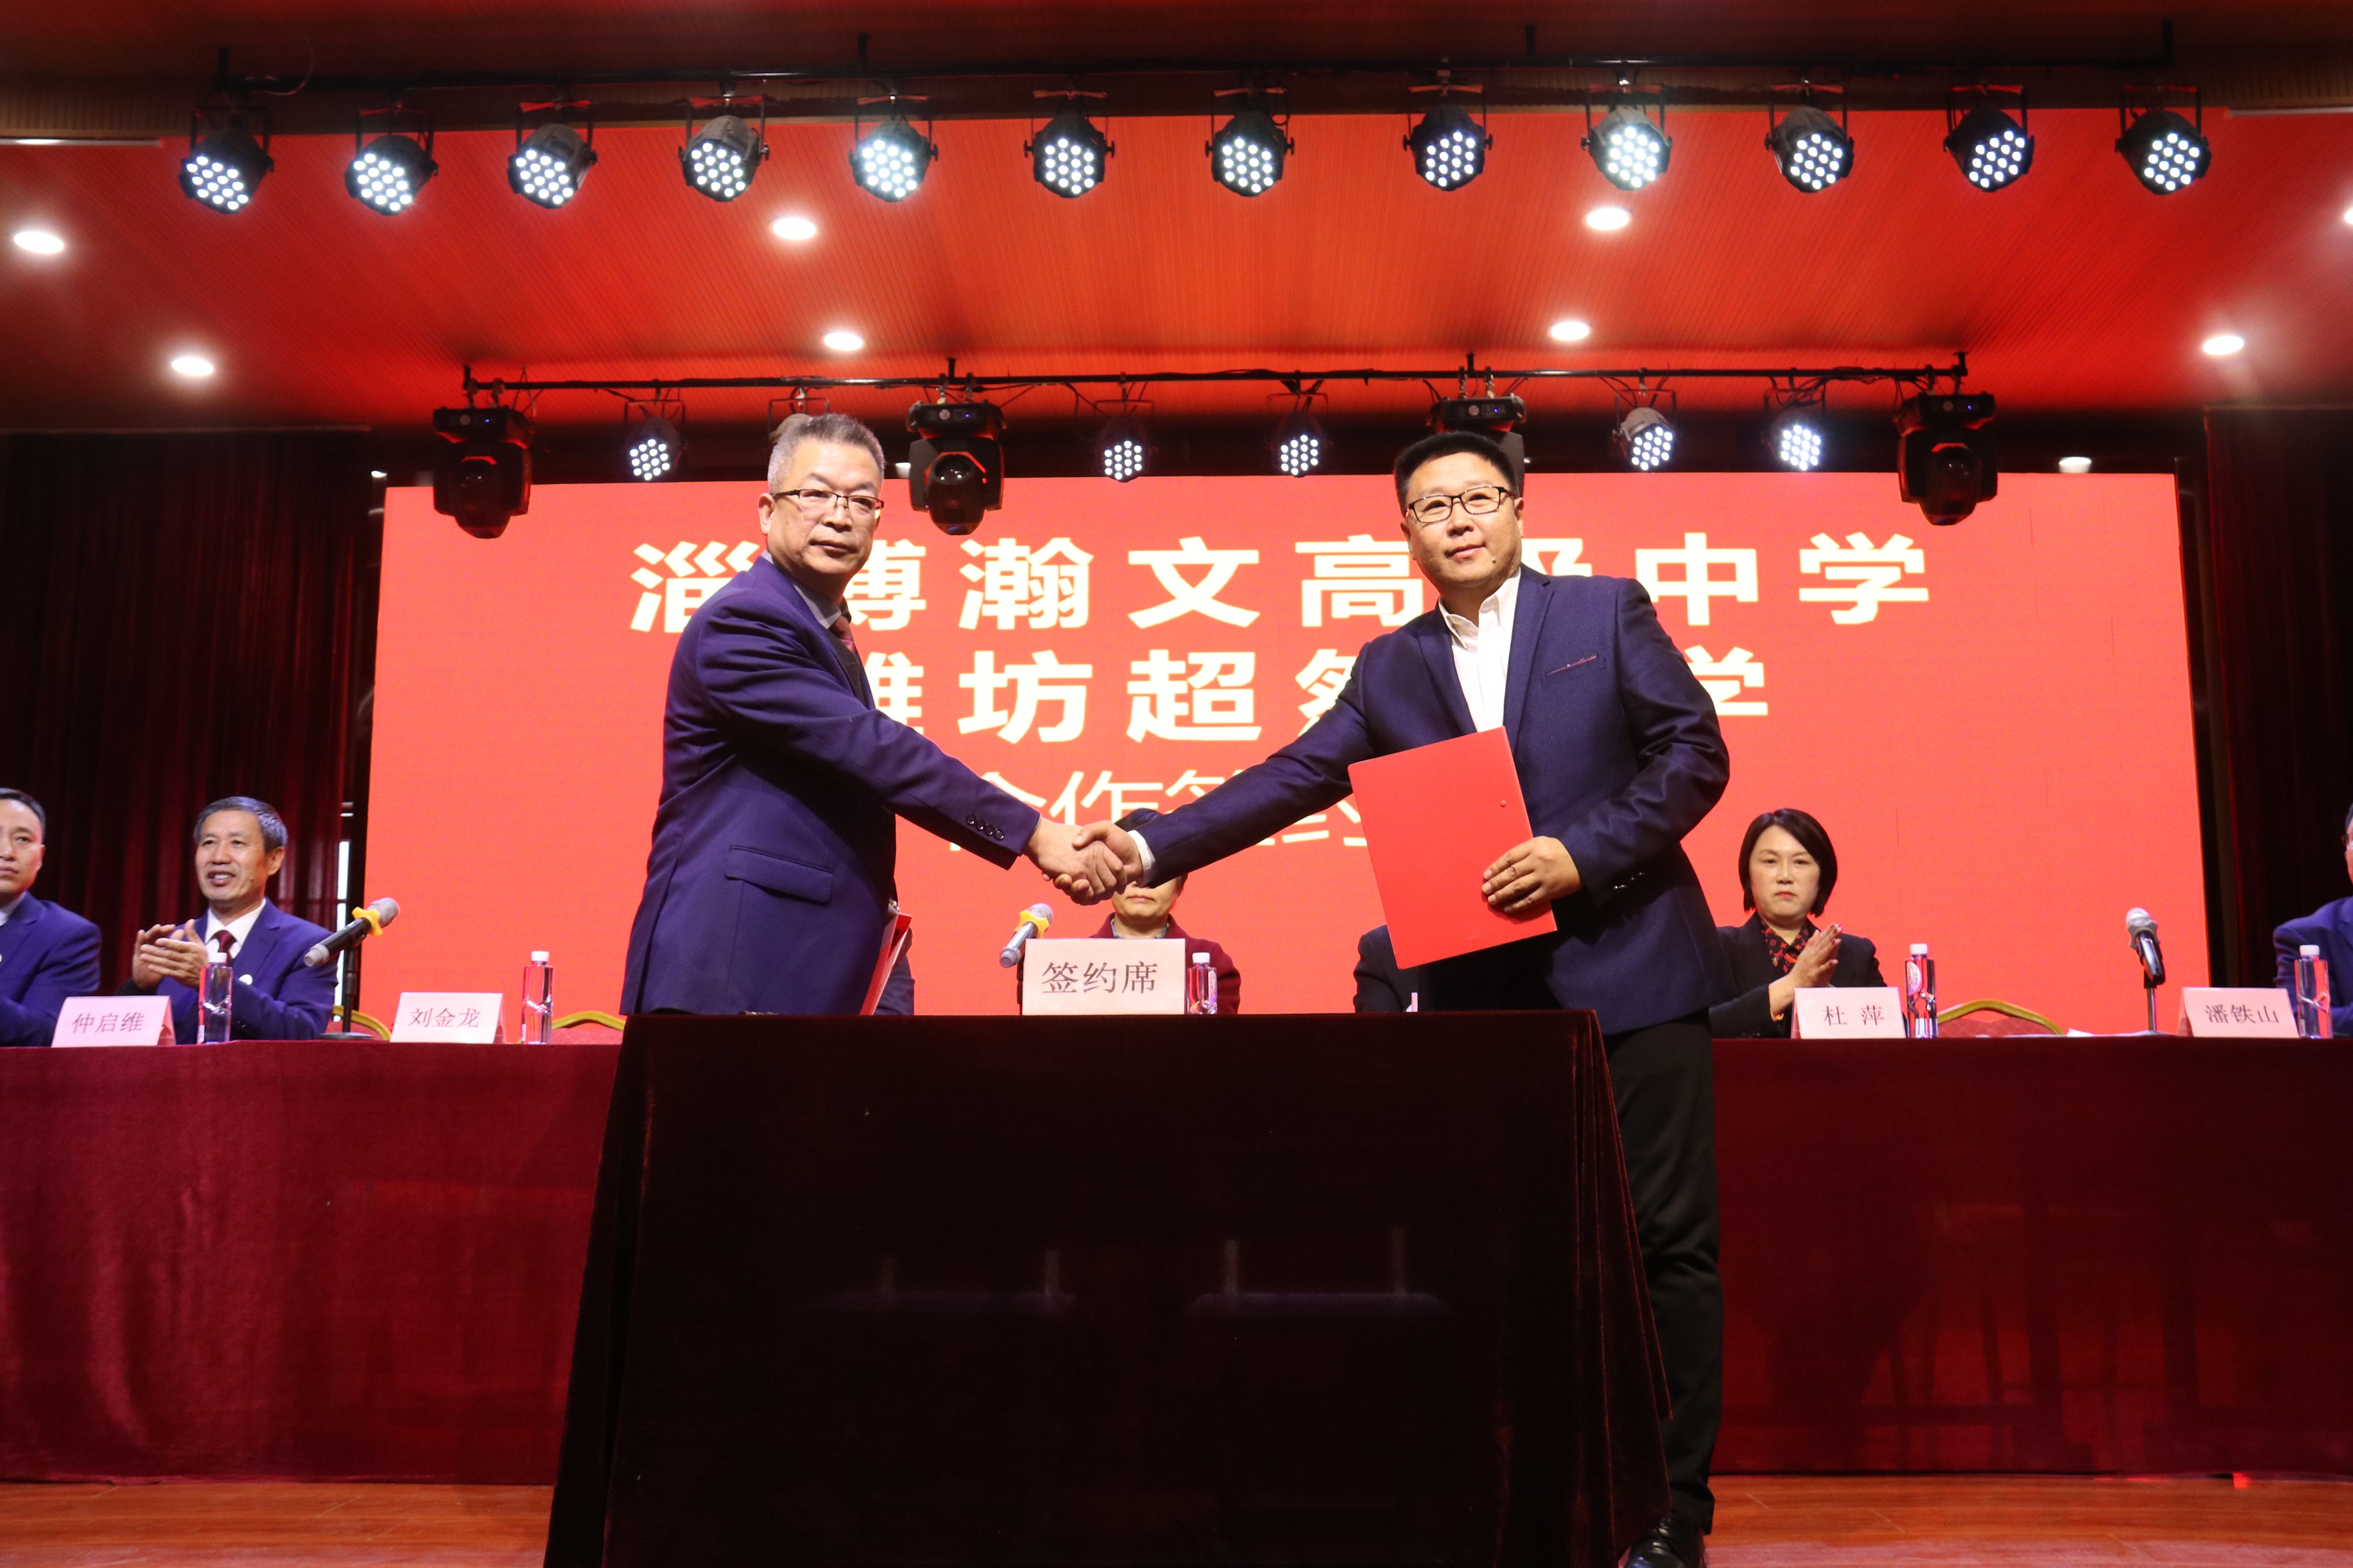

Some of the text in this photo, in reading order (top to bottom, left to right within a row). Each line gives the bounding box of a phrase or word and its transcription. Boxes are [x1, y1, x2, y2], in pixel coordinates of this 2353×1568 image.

[630, 532, 1929, 633] 淄博瀚文高中学
[1041, 960, 1158, 994] 签约席
[72, 1012, 144, 1034] 仲启维
[407, 1007, 481, 1028] 刘金龙
[1822, 1004, 1884, 1026] 杜萍
[2205, 1004, 2279, 1024] 潘铁山
